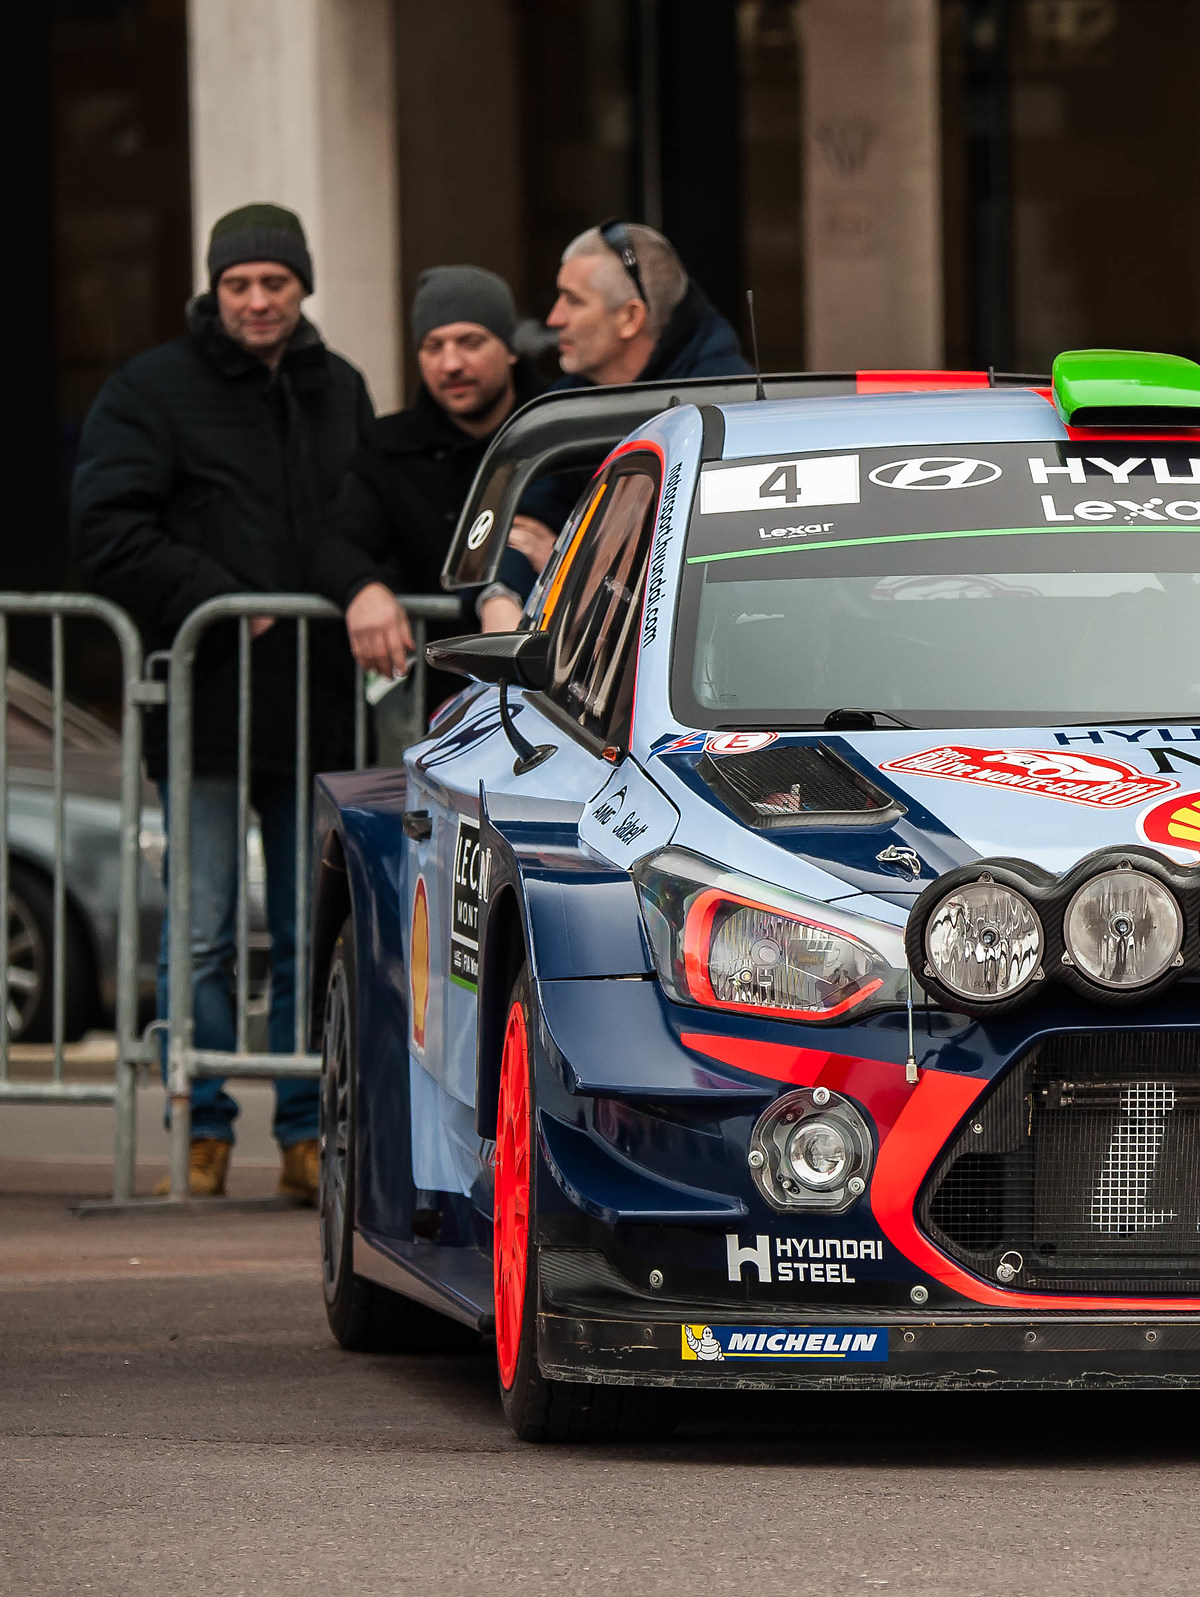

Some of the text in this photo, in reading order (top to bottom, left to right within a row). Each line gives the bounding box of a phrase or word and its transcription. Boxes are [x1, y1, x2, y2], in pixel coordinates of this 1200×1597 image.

[758, 464, 801, 504] 4
[758, 522, 835, 539] Lexar
[642, 461, 684, 649] motorsport.hyundai.com
[724, 734, 761, 749] E
[893, 751, 1148, 804] RALLYE MONTE-CARLO
[456, 836, 472, 886] LE
[775, 1237, 884, 1260] HYUNDAI
[777, 1262, 856, 1284] STEEL
[727, 1333, 878, 1352] MICHELIN
